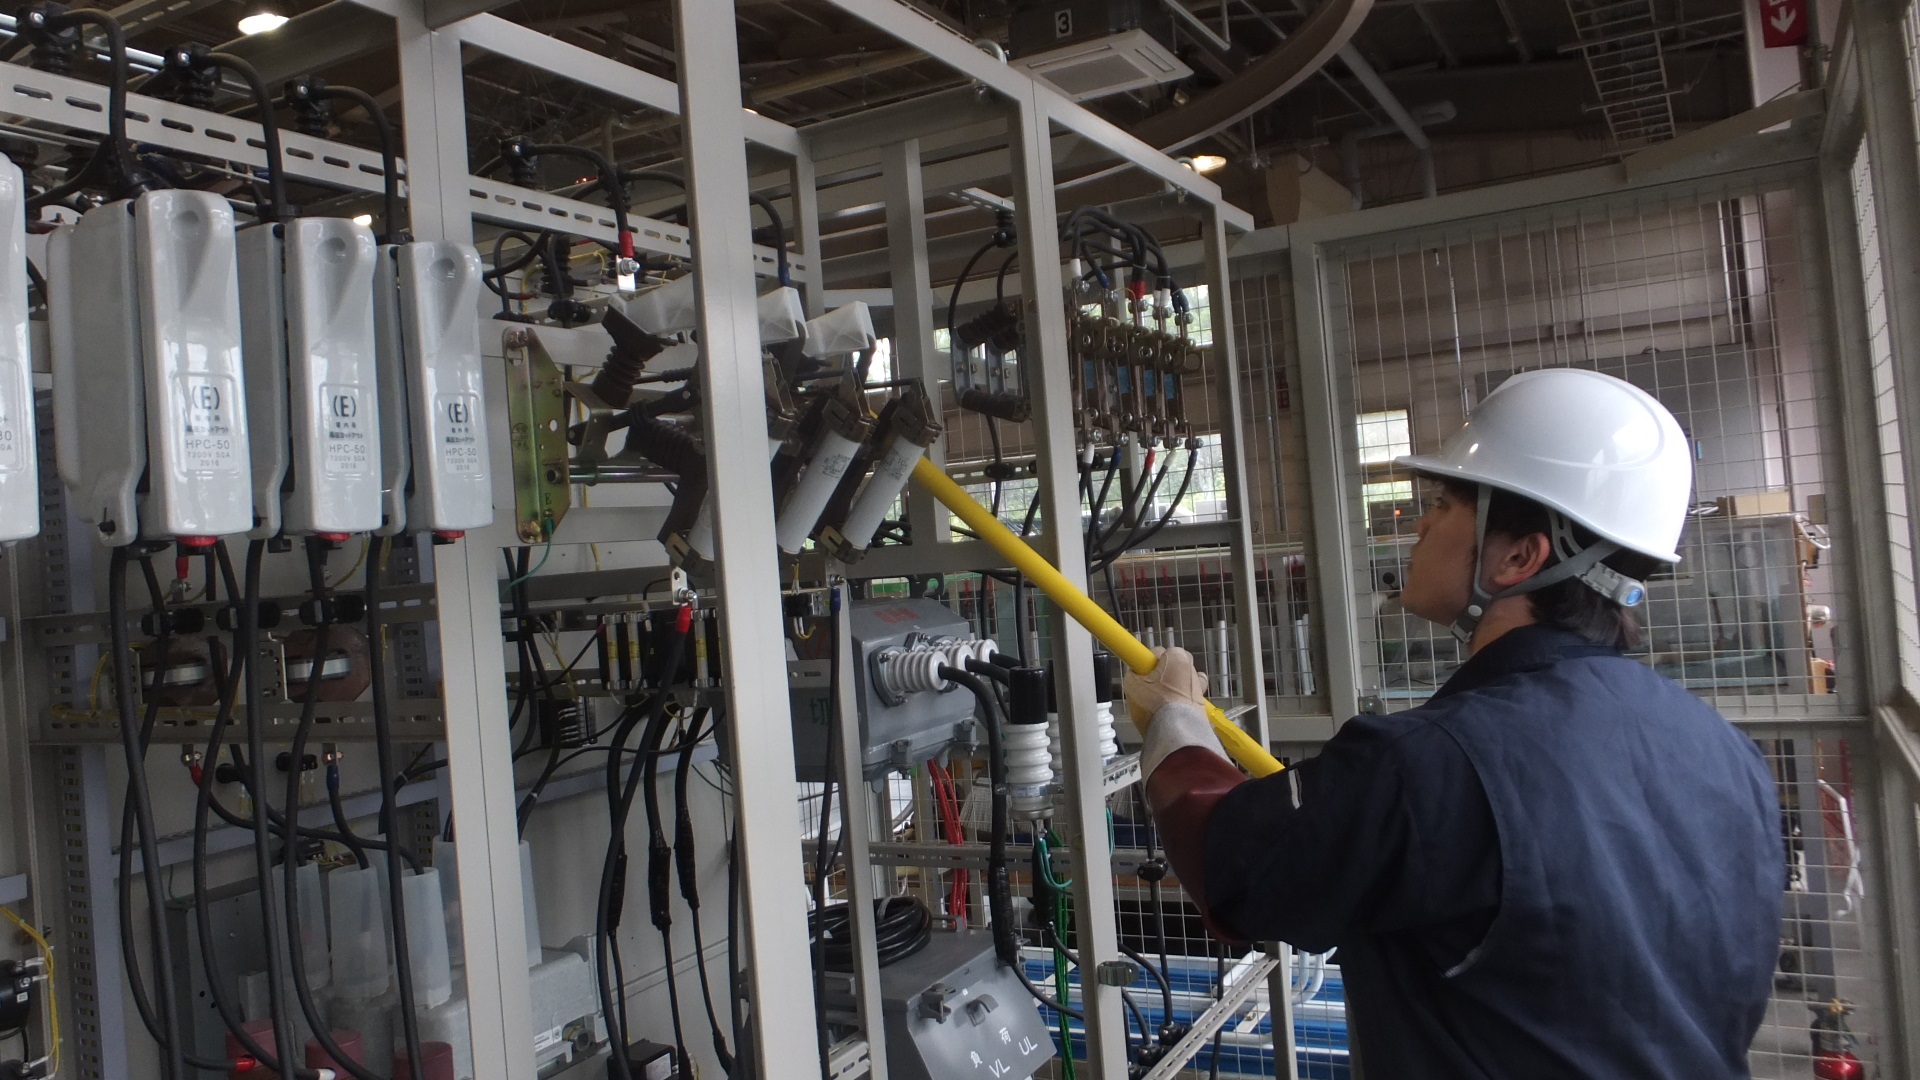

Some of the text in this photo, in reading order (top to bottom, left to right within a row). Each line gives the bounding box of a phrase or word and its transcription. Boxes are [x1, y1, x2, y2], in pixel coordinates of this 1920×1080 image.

[1058, 12, 1070, 34] 3
[186, 440, 230, 449] HPC-50
[329, 444, 366, 453] HPC-50
[445, 448, 477, 456] HPC-50
[988, 1035, 1038, 1079] VL UL
